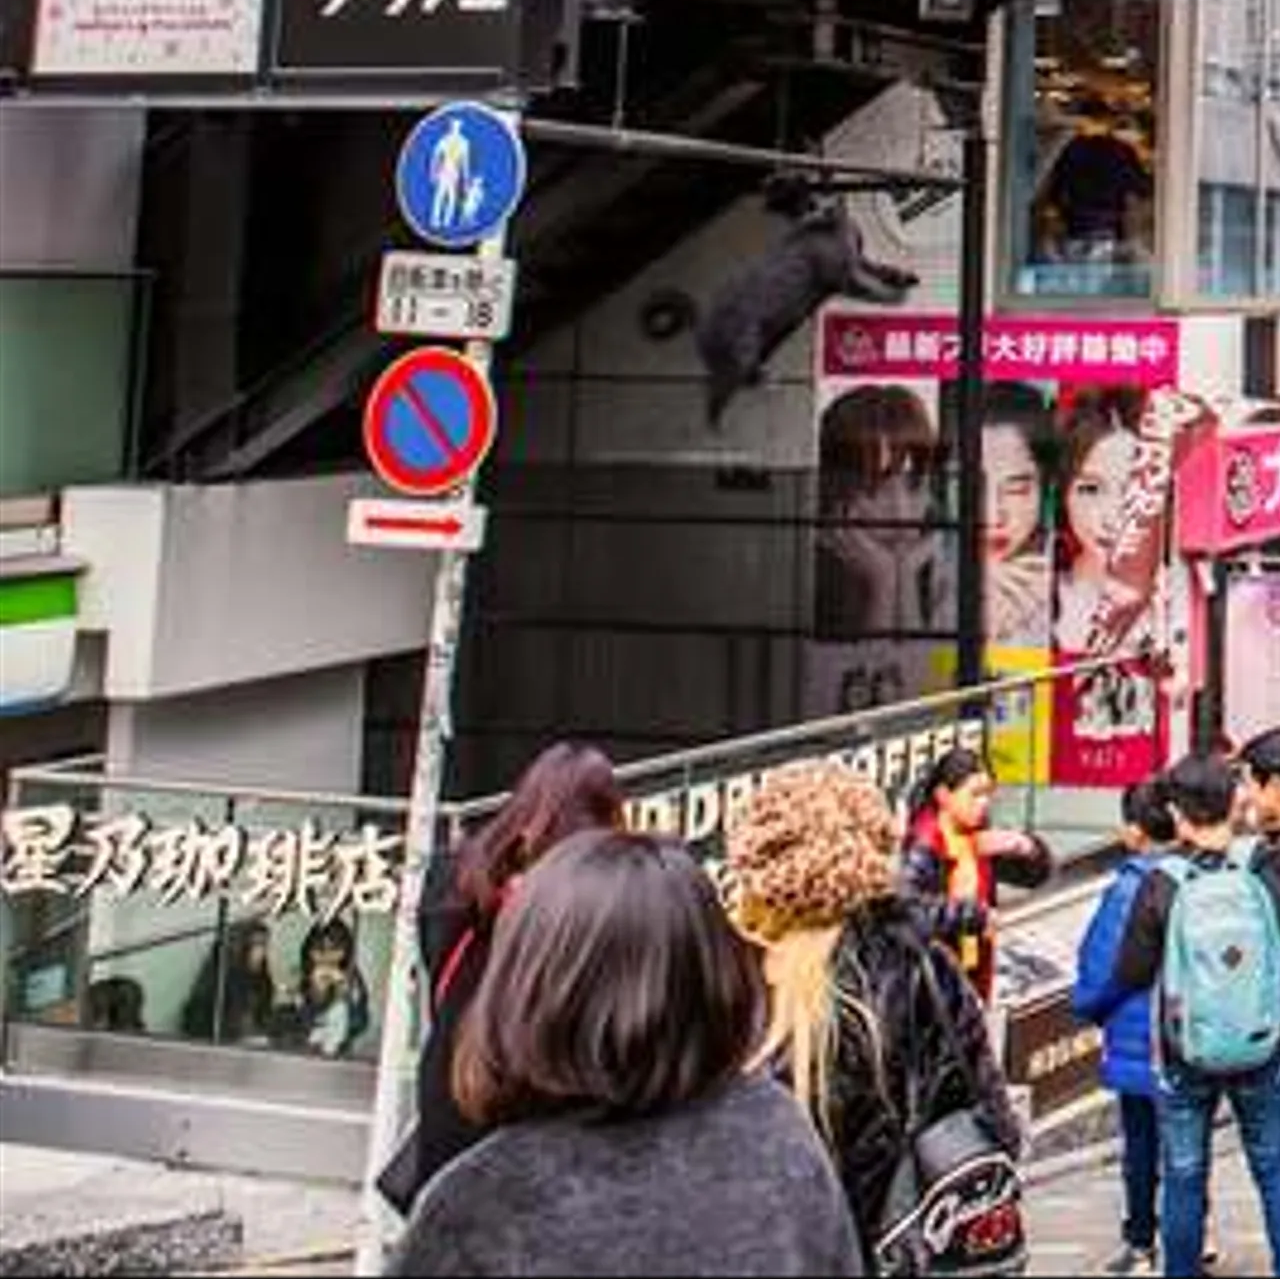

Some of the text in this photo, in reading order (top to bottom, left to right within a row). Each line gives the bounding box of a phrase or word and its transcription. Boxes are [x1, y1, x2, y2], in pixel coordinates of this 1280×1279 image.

[0, 803, 401, 922] 星乃珈琲店
